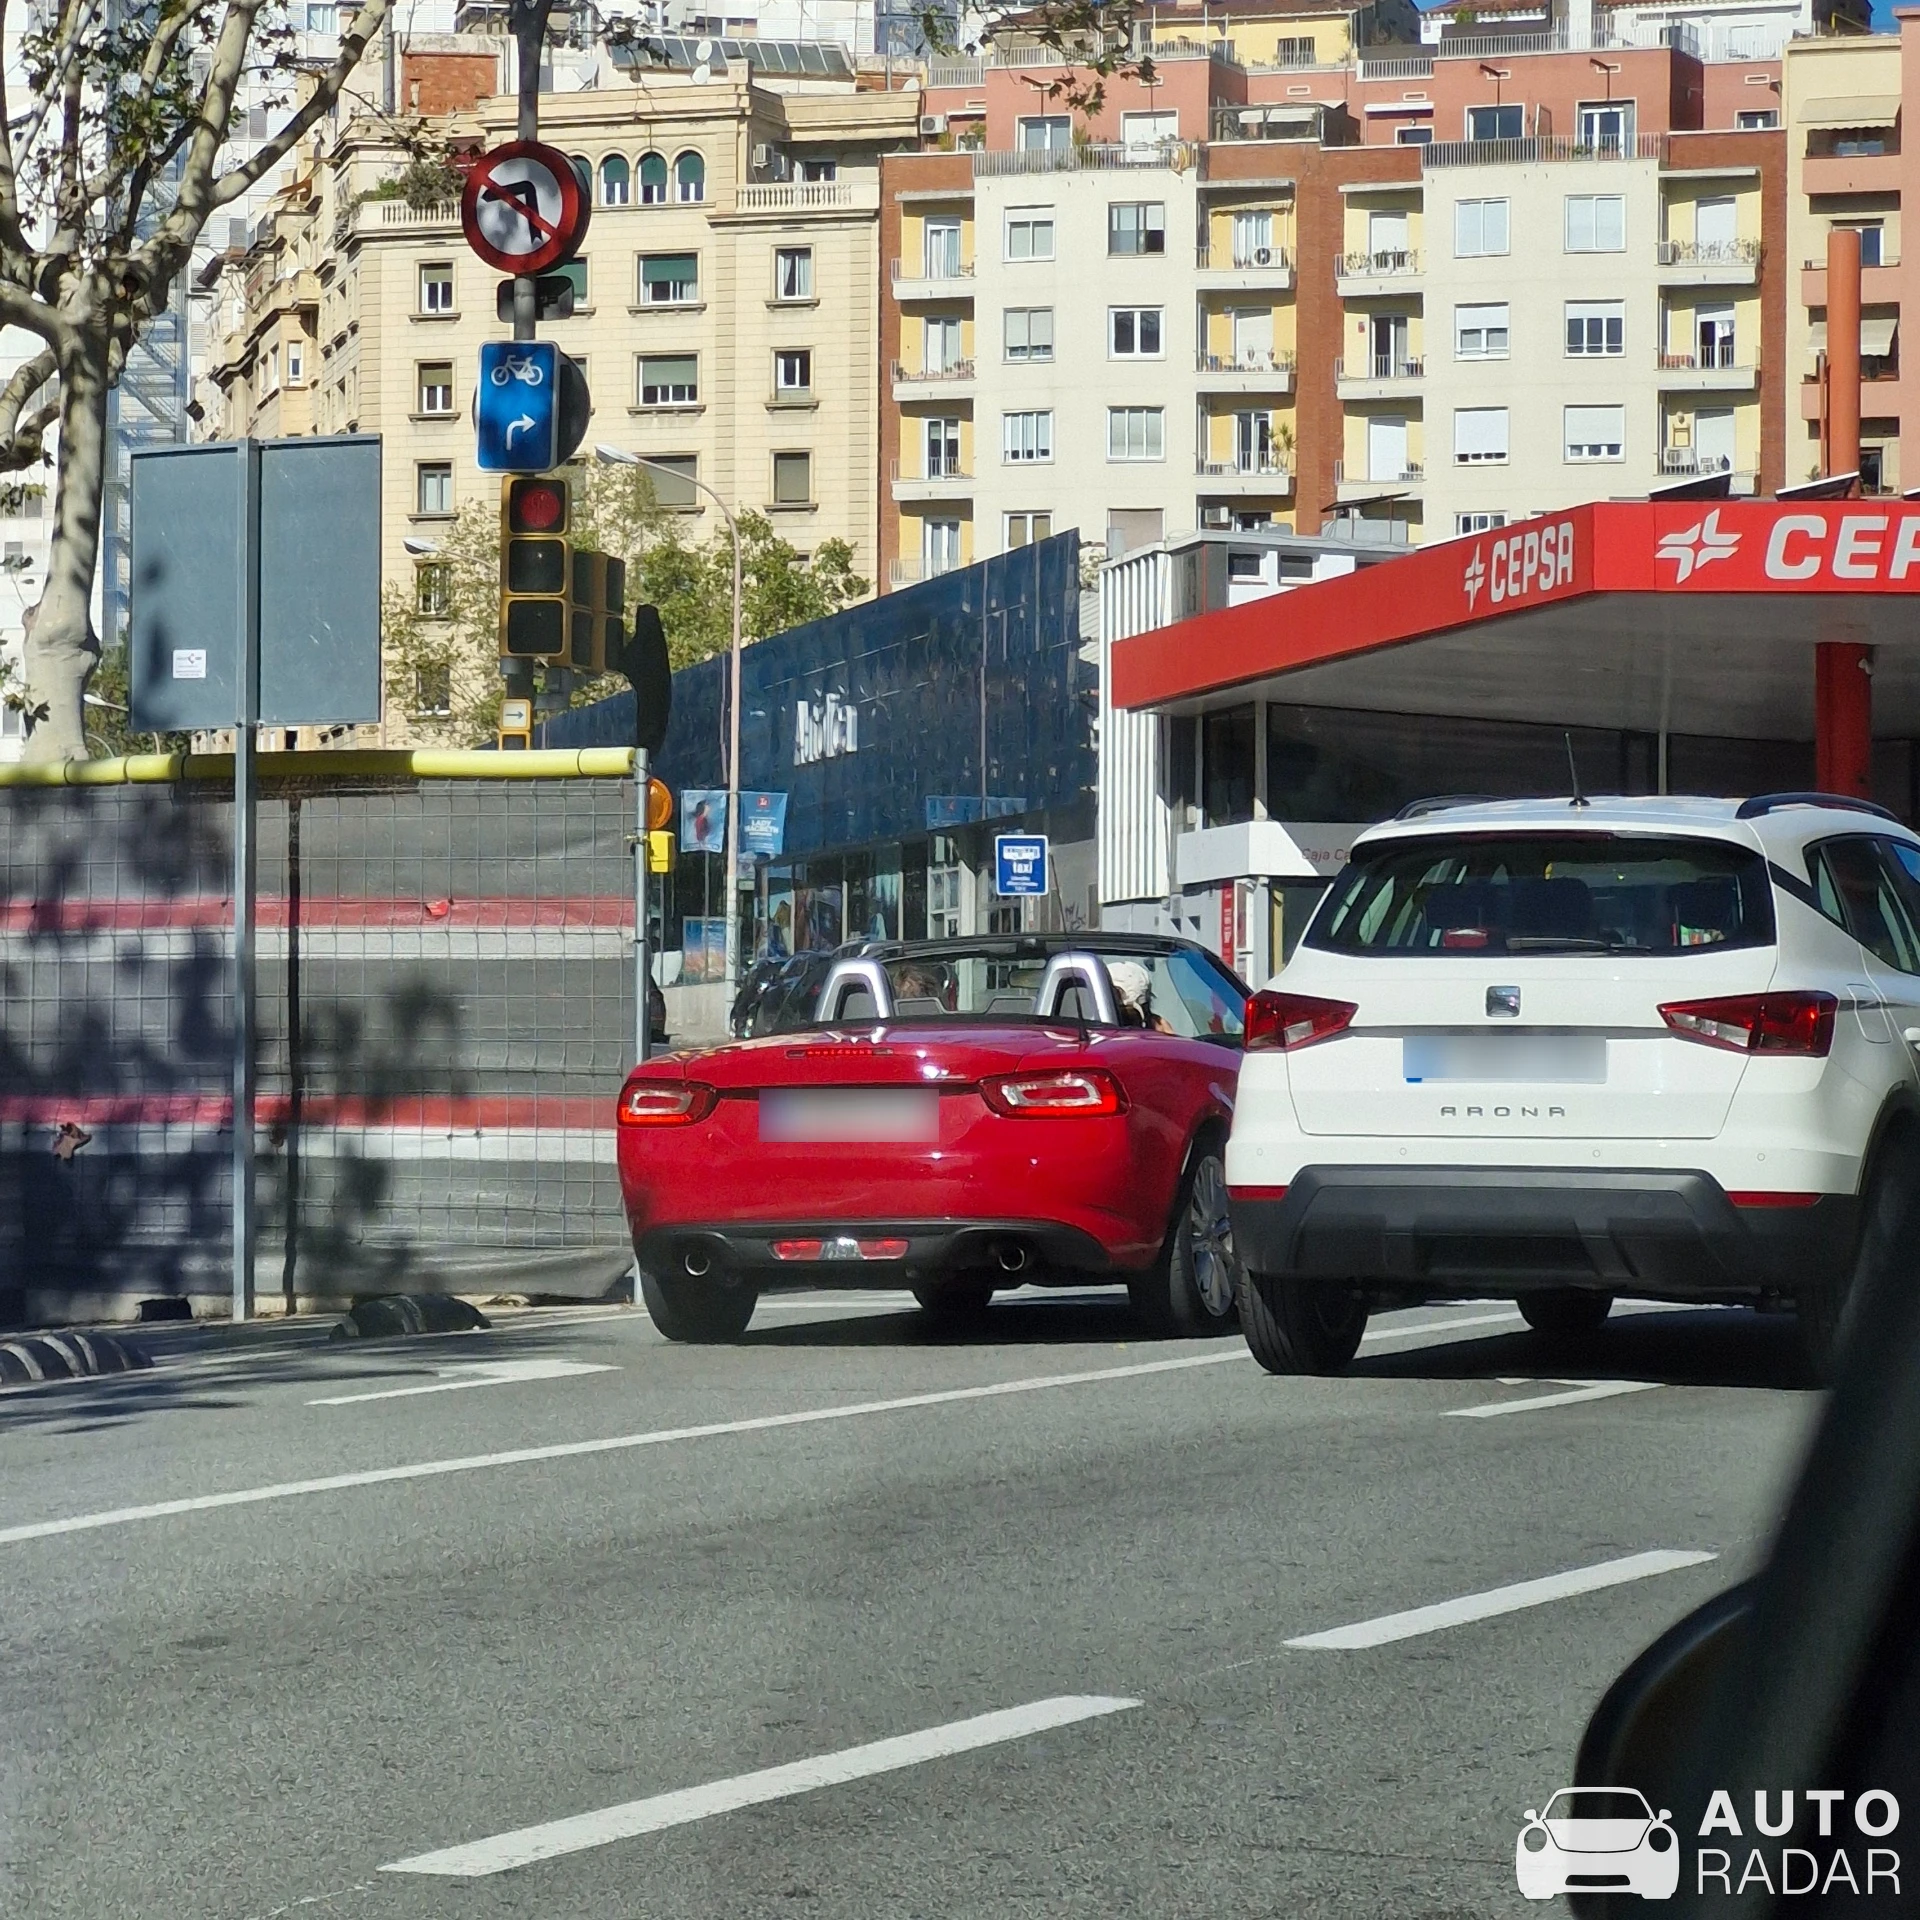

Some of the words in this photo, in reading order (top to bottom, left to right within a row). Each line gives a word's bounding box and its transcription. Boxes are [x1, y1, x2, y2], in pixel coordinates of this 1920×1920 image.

[1490, 521, 1574, 603] CEPSA
[1302, 848, 1330, 862] Caja
[1440, 1106, 1565, 1117] ARONA
